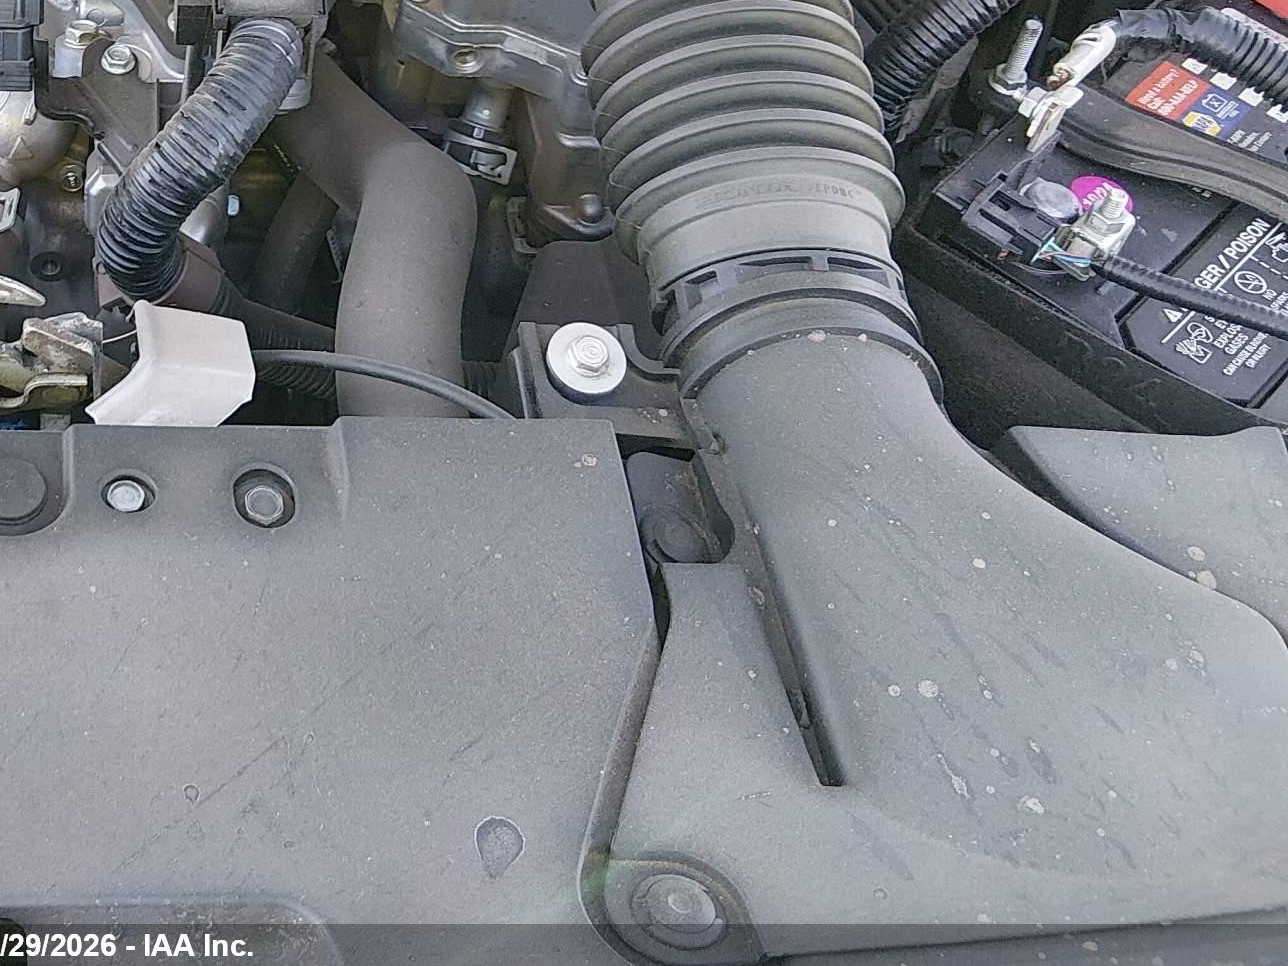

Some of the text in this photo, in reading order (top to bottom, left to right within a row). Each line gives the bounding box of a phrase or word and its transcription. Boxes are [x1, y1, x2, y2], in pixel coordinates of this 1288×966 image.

[1224, 217, 1271, 260] POISON
[1224, 334, 1249, 355] GASES
[1223, 362, 1238, 376] CAN
